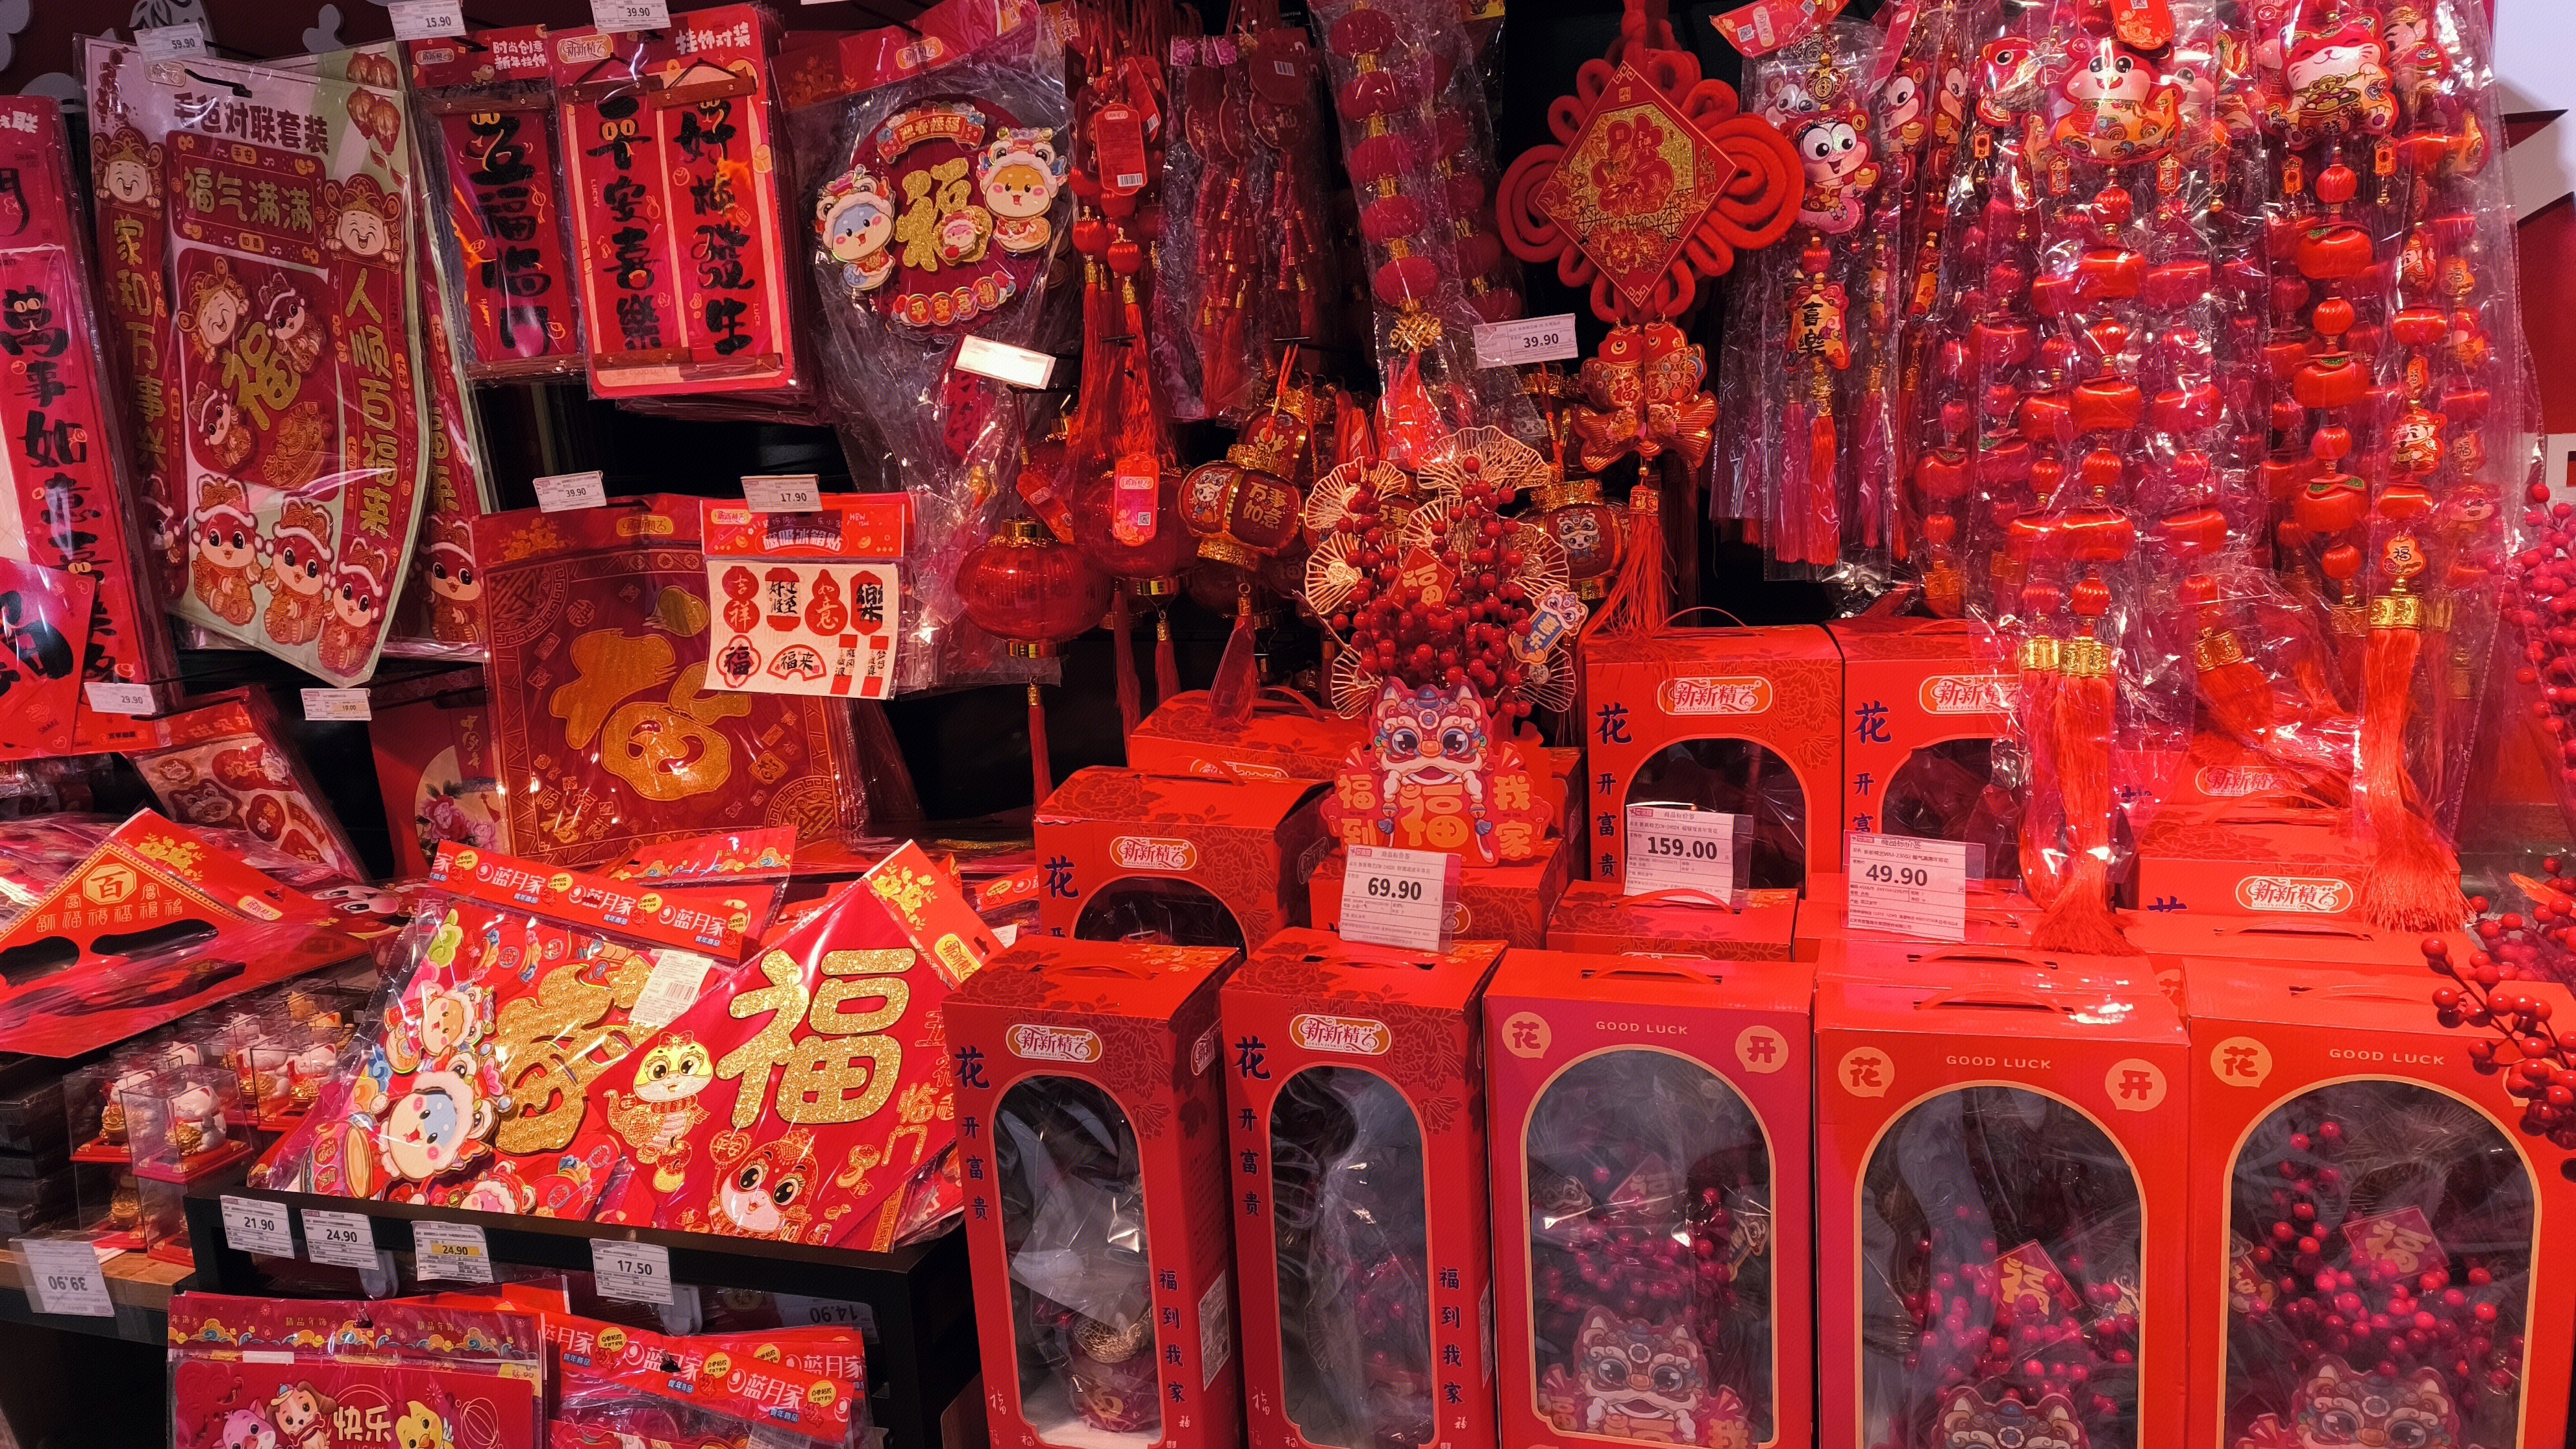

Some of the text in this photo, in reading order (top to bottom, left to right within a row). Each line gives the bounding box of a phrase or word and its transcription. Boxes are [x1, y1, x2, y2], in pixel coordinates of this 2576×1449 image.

[425, 16, 451, 28] 15.90
[626, 6, 650, 18] 39.90
[171, 38, 195, 49] 59.90
[493, 40, 544, 55] 时尚创意
[675, 21, 751, 56] 挂饰对装
[494, 54, 547, 70] 新年挂饰
[184, 166, 312, 234] 福气满满
[590, 179, 600, 208] LUCKY
[1523, 333, 1559, 348] 39.90
[221, 321, 303, 431] 福
[781, 492, 807, 502] 17.90
[763, 528, 844, 552] 磁吸冰箱贴
[2394, 545, 2412, 562] 福
[727, 573, 752, 632] 吉祥
[815, 582, 839, 630] 如意
[725, 645, 750, 675] 福
[121, 695, 143, 704] 29.90
[1669, 680, 1759, 712] 新新精艺
[38, 717, 60, 736] SNAKE
[1593, 702, 1633, 878] 花开富贵
[1338, 774, 1378, 846] 福到
[1399, 782, 1469, 848] 福
[1492, 774, 1533, 858] 我家
[1119, 839, 1188, 868] 新新精艺
[1648, 836, 1717, 860] 159.00
[90, 871, 127, 901] 百
[492, 866, 547, 894] 蓝月家
[1368, 877, 1422, 900] 69.90
[1866, 864, 1928, 886] 49.90
[2248, 878, 2338, 910] 新新精艺
[673, 908, 726, 938] 蓝月家
[714, 947, 917, 1128] 福
[1300, 1017, 1378, 1052] 新新精艺
[1511, 1021, 1541, 1051] 花
[1596, 1021, 1689, 1036] GOOD LUCK
[1017, 1028, 1091, 1059] 新新精艺
[1746, 1035, 1777, 1063] 开
[2329, 1048, 2446, 1067] GOOD LUCK
[1850, 1056, 1883, 1089] 花
[1946, 1054, 2053, 1071] GOOD LUCK
[2223, 1045, 2259, 1078] 花
[2118, 1069, 2153, 1101] 开
[954, 1046, 990, 1222] 花开富贵
[1235, 1035, 1272, 1218] 花开富贵
[713, 1139, 743, 1158] 平安
[852, 1182, 869, 1196] 福
[244, 1217, 275, 1231] 21.90
[327, 1229, 357, 1243] 24.90
[442, 1245, 469, 1256] 24.90
[2365, 1219, 2433, 1274] 福
[617, 1259, 652, 1276] 17.50
[48, 1276, 88, 1291] 39.90
[1159, 1269, 1186, 1404] 福到我家
[1438, 1266, 1465, 1406] 福到我家
[741, 1372, 805, 1411] 蓝月家
[333, 1405, 392, 1443] 快乐
